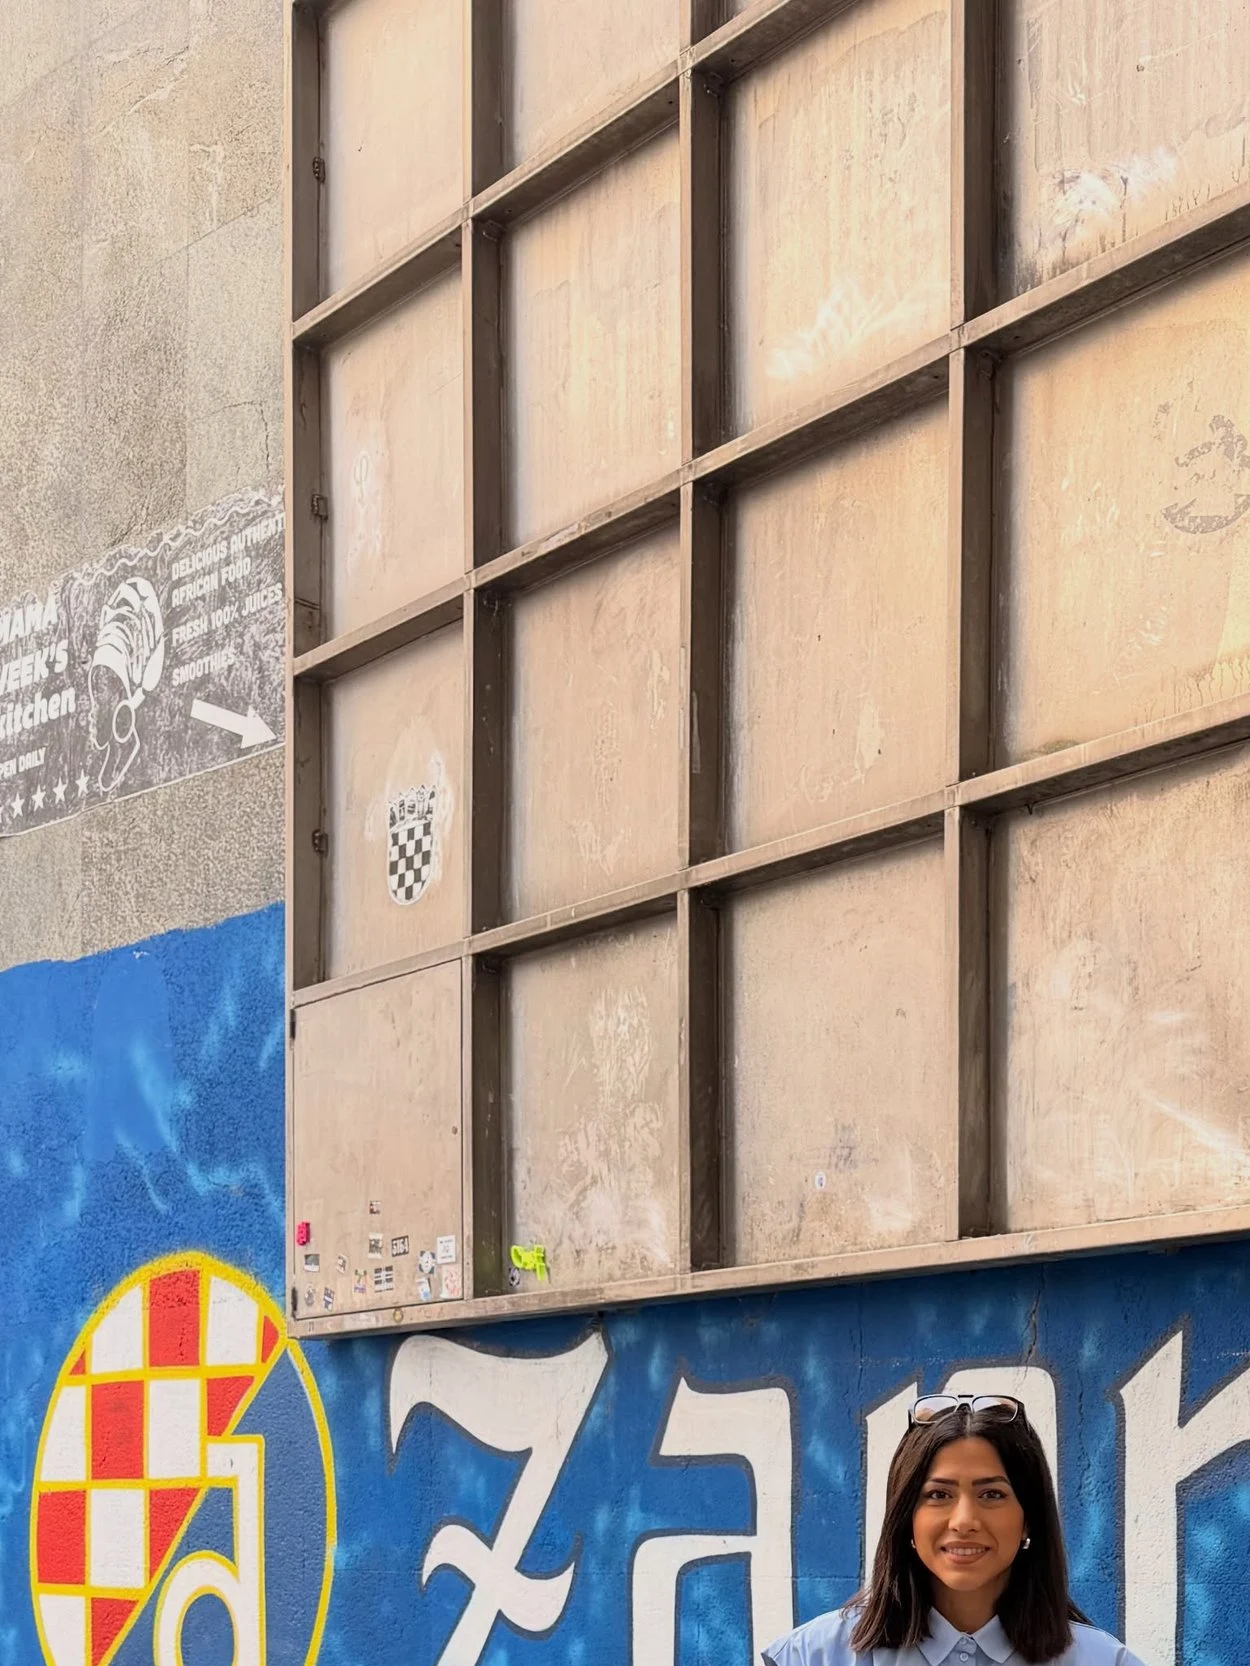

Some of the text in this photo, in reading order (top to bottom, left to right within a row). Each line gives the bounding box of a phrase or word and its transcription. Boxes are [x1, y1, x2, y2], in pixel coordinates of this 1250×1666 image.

[172, 540, 228, 581] DELICIOUS
[172, 557, 251, 608] AFRICAN FOOD
[172, 583, 283, 647] FRESH 100% JUICES
[172, 648, 235, 686] SMOOTHIES
[18, 747, 46, 773] DAILY
